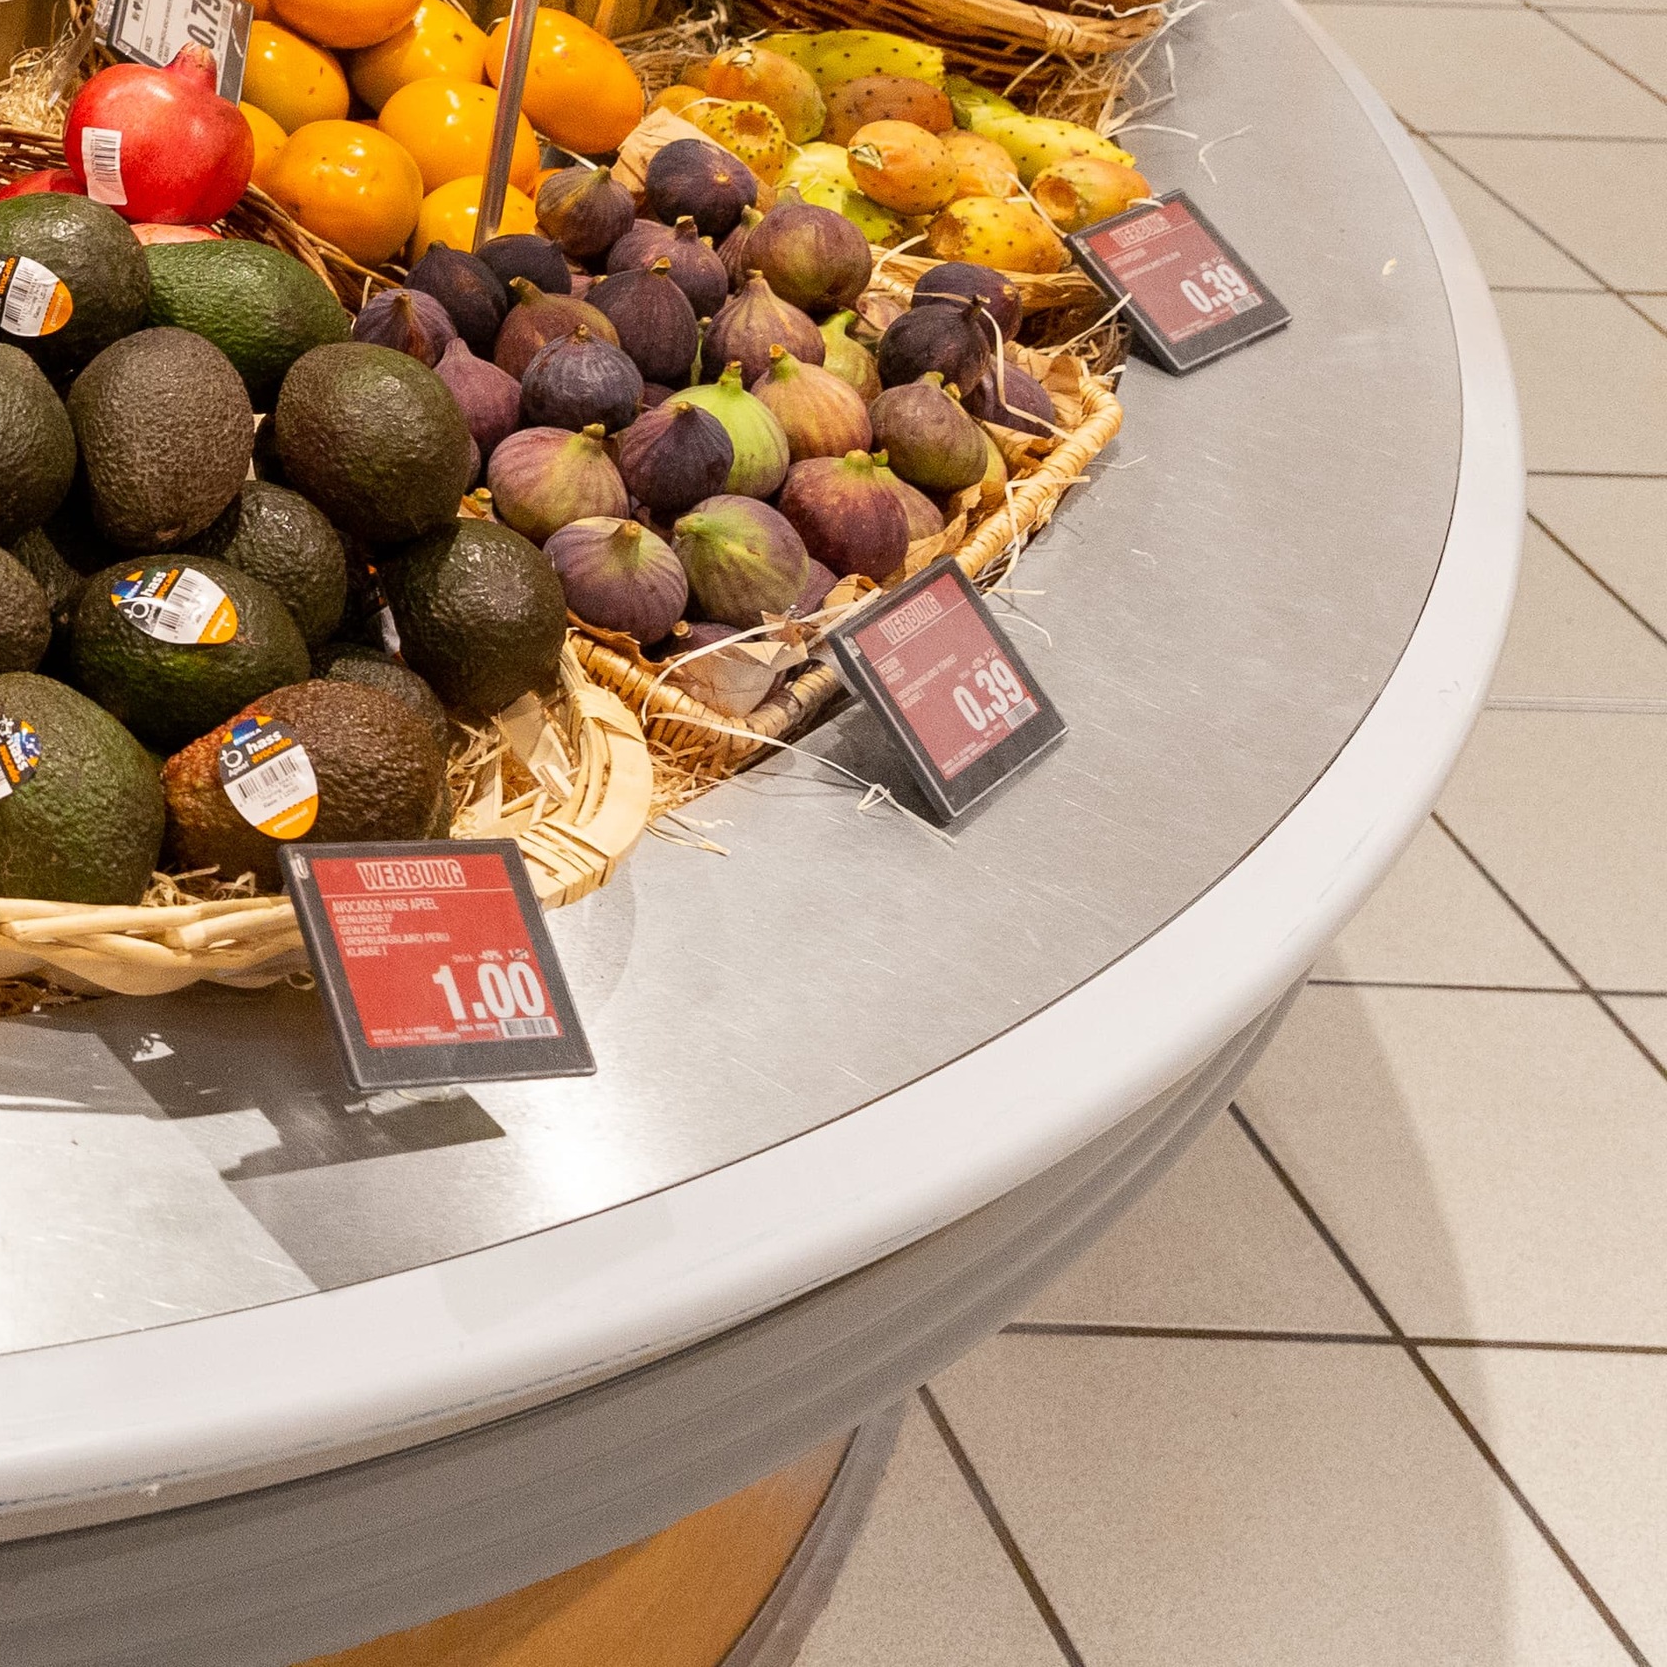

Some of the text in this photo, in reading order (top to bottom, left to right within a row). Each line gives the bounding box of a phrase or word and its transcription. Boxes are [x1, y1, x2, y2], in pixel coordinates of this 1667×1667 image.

[1180, 263, 1249, 314] 0.39
[140, 571, 167, 598] hass
[877, 590, 943, 646] WERBUNG
[953, 659, 1024, 732] 0.39
[245, 730, 283, 755] hass
[356, 859, 467, 891] WERBUNG
[332, 897, 383, 914] AVOCADOS
[383, 898, 410, 913] HASS
[432, 962, 546, 1021] 1.00
